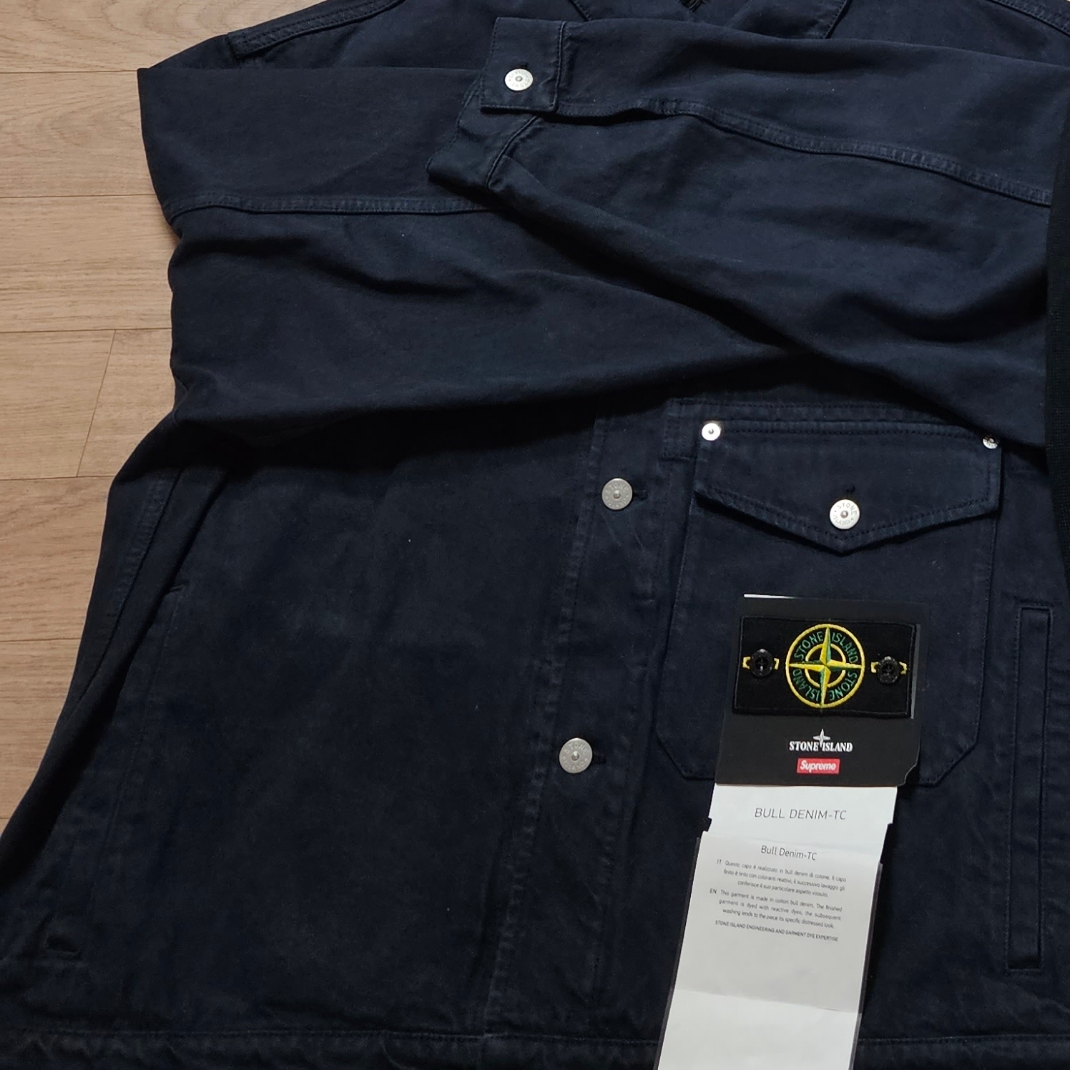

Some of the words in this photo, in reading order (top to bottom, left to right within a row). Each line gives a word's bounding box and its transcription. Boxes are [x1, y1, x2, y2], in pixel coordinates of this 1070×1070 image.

[836, 502, 858, 516] STONE
[793, 631, 824, 660] STONE
[831, 632, 859, 664] ISLAND
[792, 669, 821, 702] ISLAND
[829, 672, 858, 701] STONE
[789, 741, 819, 751] STONE
[822, 741, 853, 752] ISLAND
[800, 760, 837, 772] Supreme
[755, 808, 786, 819] BULL
[789, 809, 847, 821] DENIM-TC
[761, 845, 777, 855] Bull
[779, 847, 817, 861] Denim-TC
[746, 924, 775, 933] ENGINEERING
[785, 929, 806, 937] GARMENT
[816, 933, 838, 942] EXPERTISE
